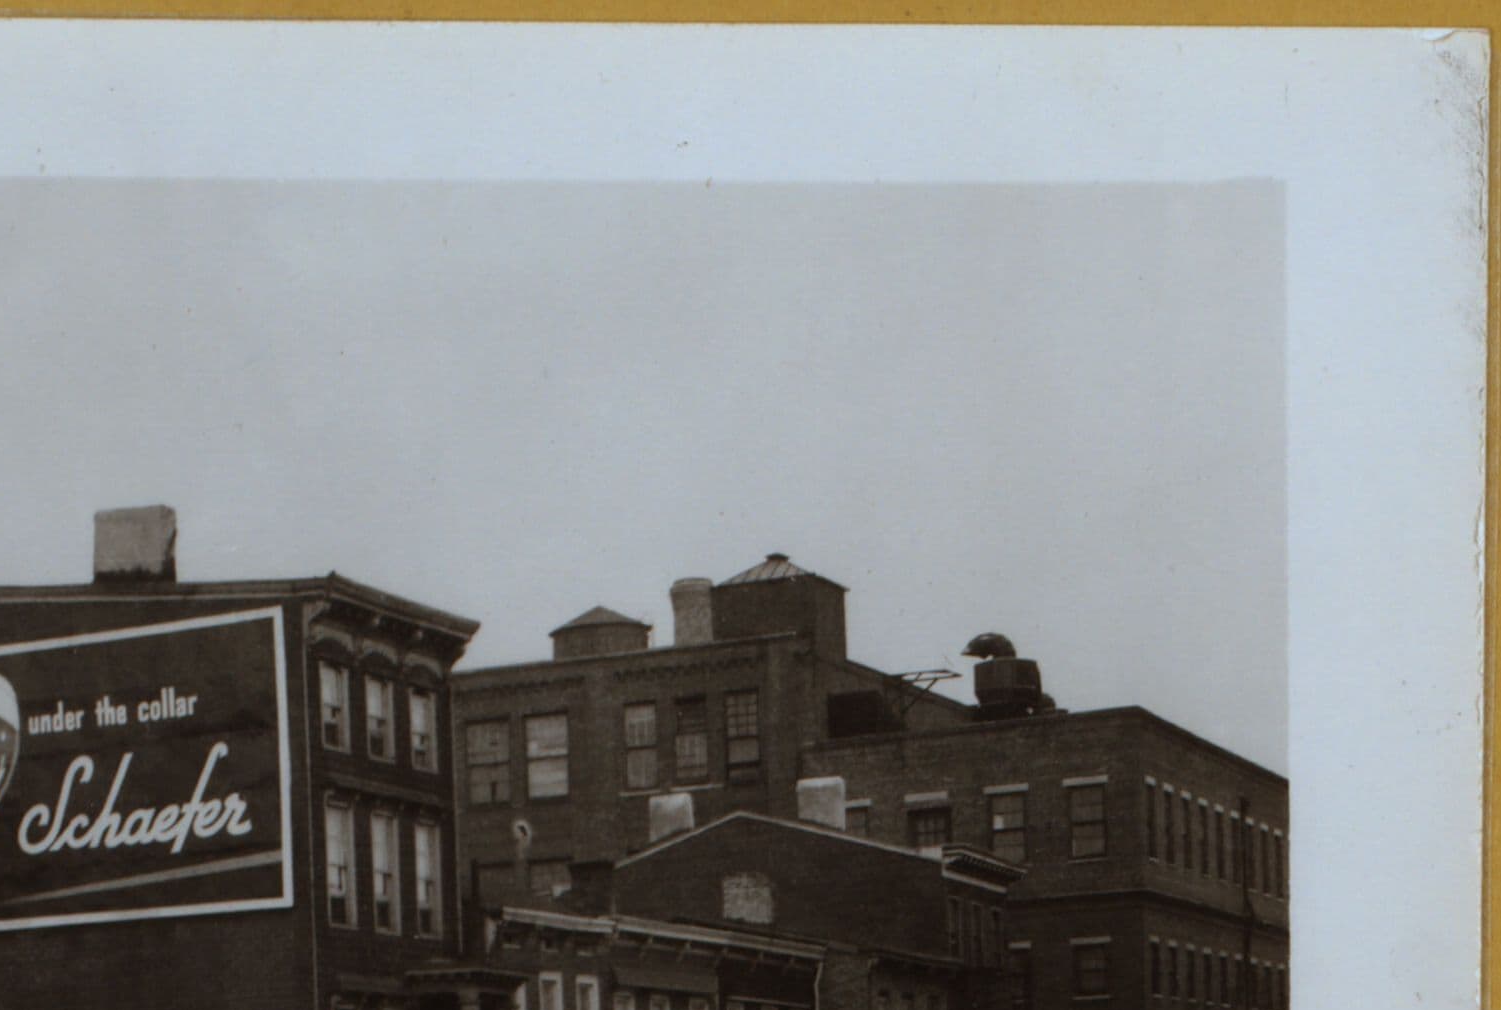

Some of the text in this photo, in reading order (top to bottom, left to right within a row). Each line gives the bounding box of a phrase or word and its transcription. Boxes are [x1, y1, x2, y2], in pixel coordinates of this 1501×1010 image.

[28, 686, 198, 735] under the collar
[18, 741, 253, 856] Schaefer
